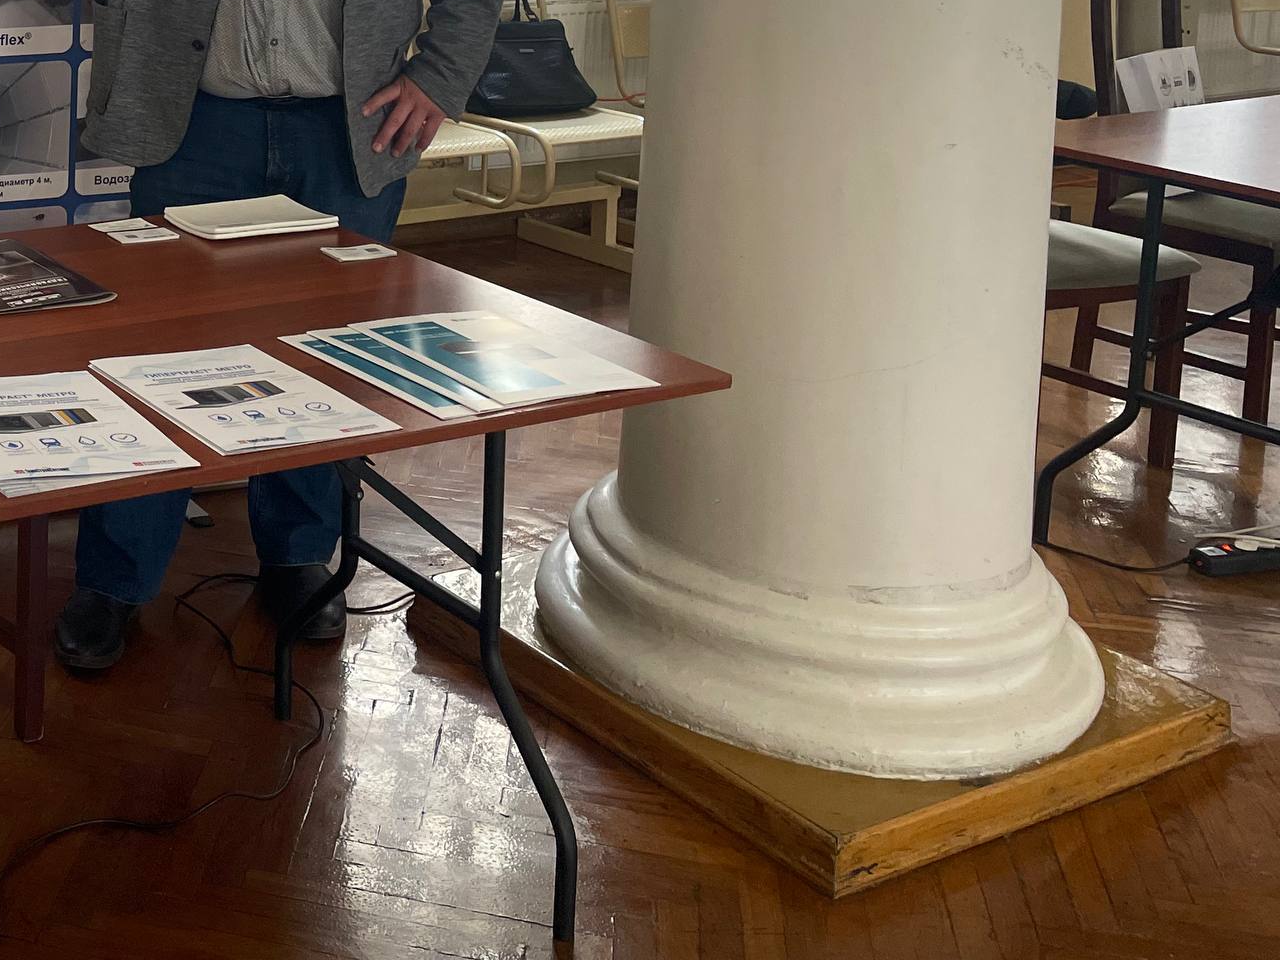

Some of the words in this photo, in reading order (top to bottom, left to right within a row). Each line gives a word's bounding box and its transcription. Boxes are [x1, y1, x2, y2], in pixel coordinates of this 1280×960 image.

[36, 176, 42, 184] 4
[94, 175, 133, 187] Водоз
[215, 364, 251, 372] МЕТРО
